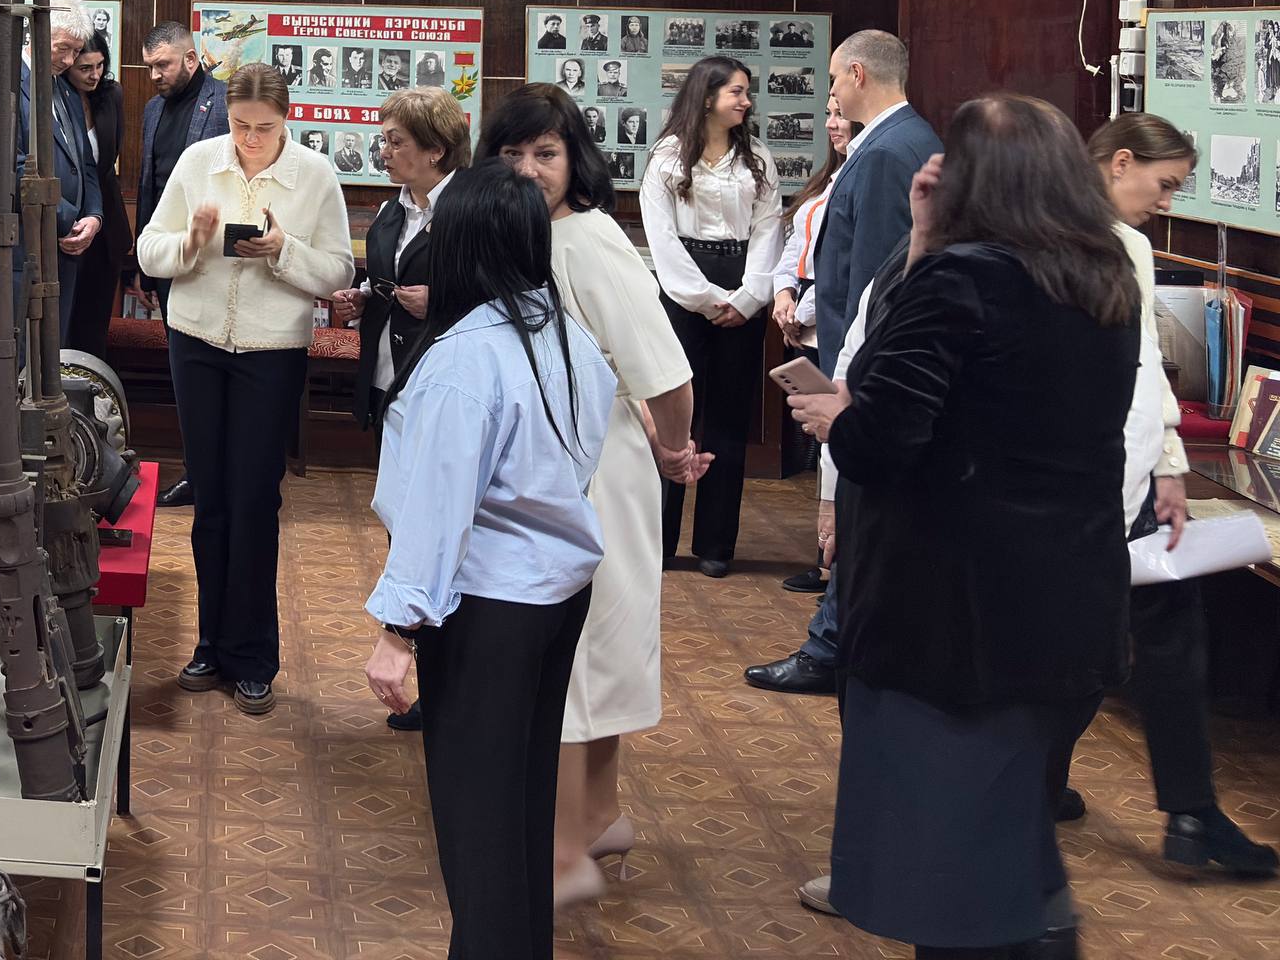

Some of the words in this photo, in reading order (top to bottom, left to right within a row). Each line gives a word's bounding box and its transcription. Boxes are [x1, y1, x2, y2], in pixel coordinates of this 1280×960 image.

[282, 15, 371, 28] ВЫПУСКНИКИ
[385, 18, 466, 31] АЭРОКЛУБА
[313, 107, 351, 121] БОЯХ
[361, 110, 380, 122] ЗА
